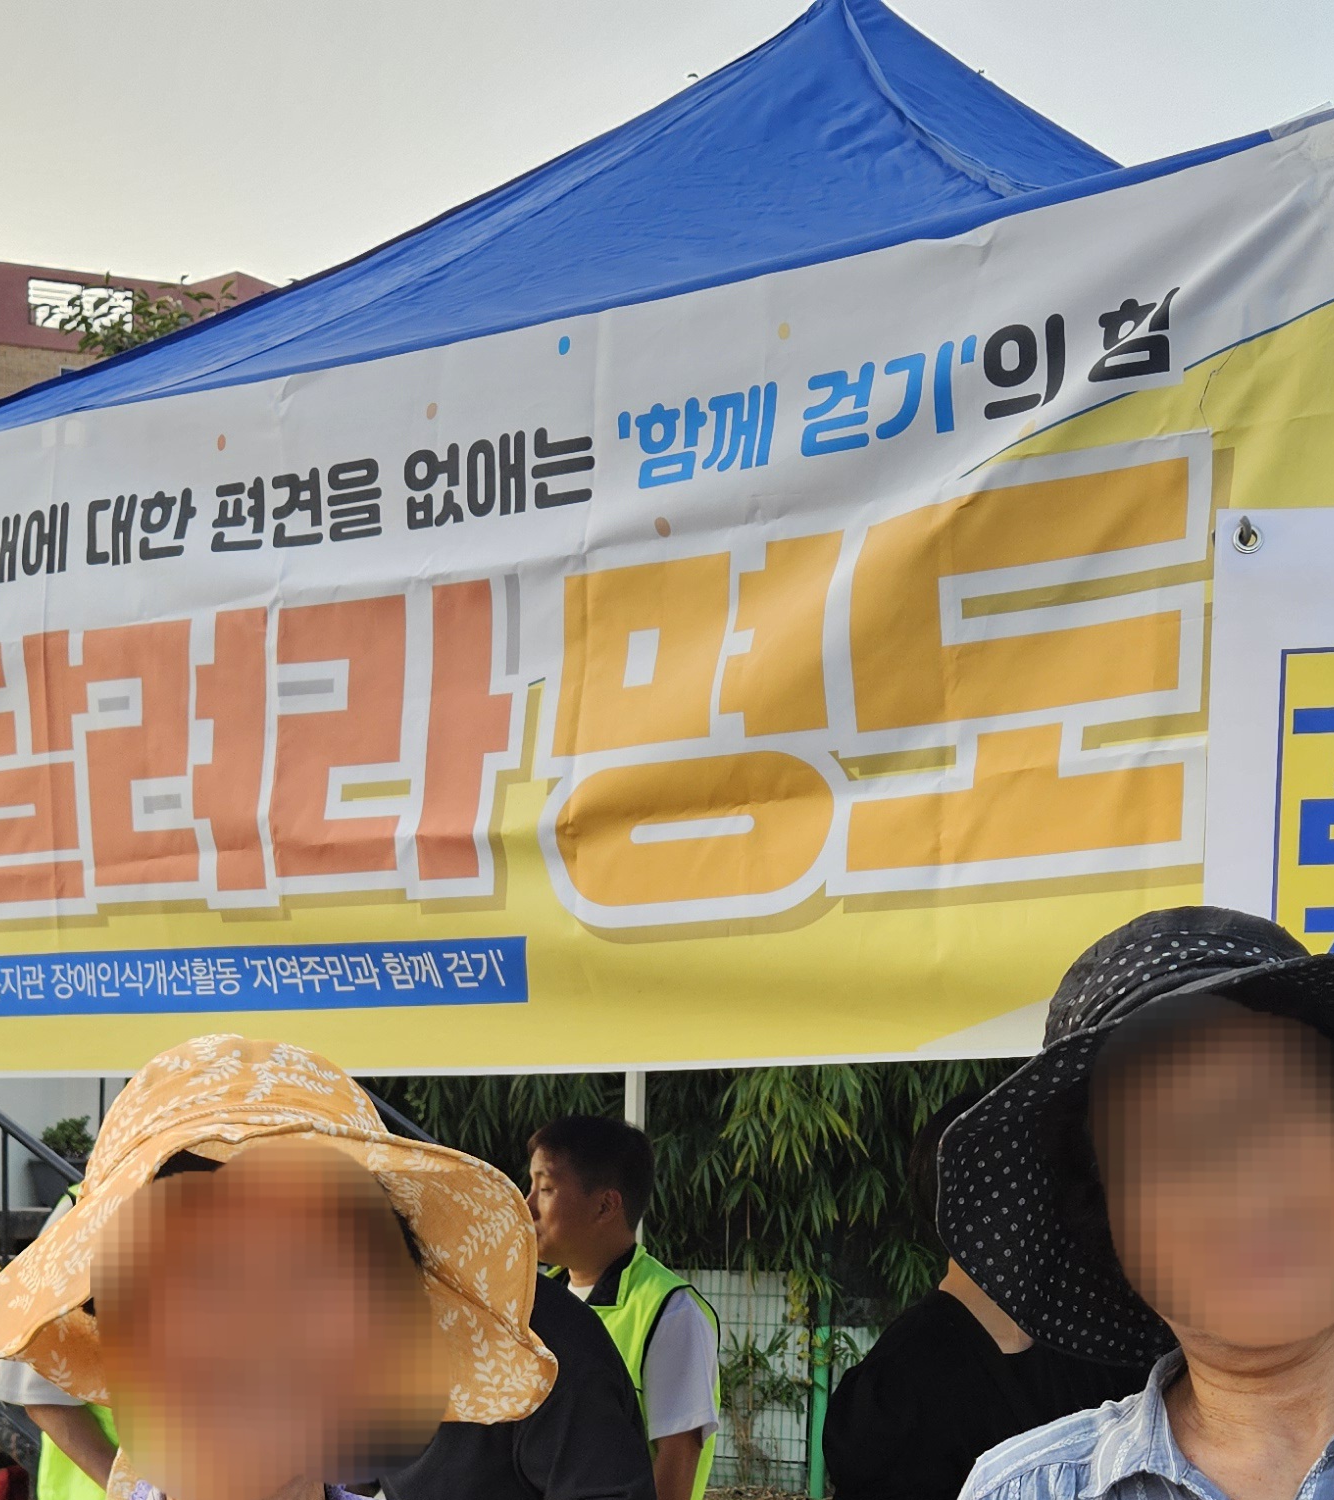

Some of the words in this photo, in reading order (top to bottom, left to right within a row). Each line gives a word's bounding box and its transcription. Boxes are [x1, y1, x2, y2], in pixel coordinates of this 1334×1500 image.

[85, 486, 197, 566] 대한
[210, 457, 383, 552] 편견을
[402, 426, 596, 530] 없애는
[617, 380, 778, 490] '함께
[800, 312, 1066, 458] 걷기'의
[1087, 286, 1181, 383] 힘
[551, 457, 1190, 907] 명도
[50, 957, 242, 999] 장애인식개선활동
[243, 952, 381, 994] '지역주민과
[381, 951, 444, 991] 함께
